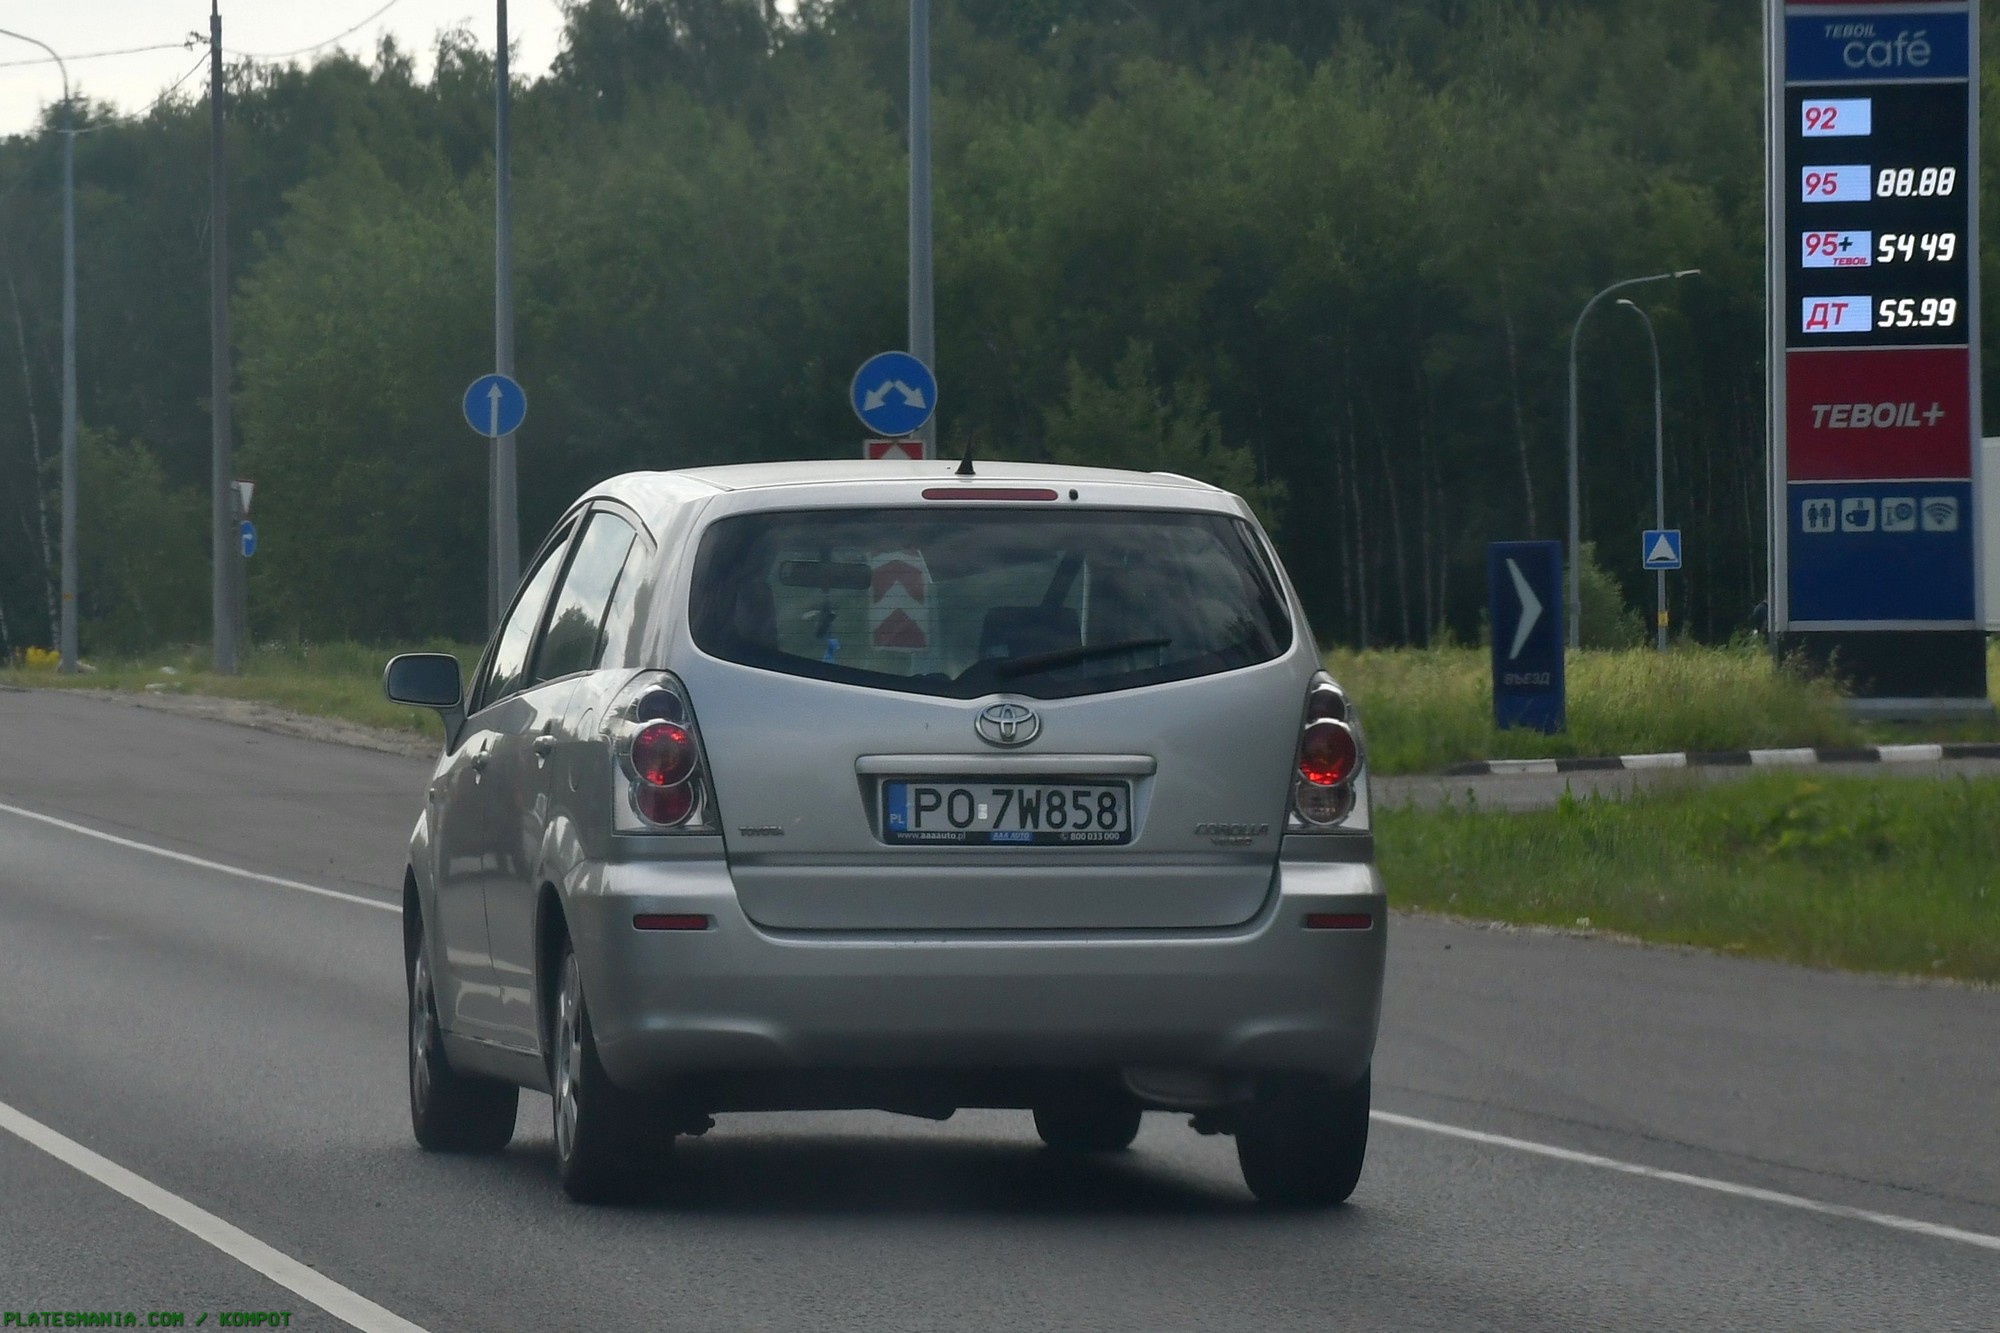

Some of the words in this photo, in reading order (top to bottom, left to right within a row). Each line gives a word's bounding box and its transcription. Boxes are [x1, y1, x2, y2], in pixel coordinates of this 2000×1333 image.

[1824, 24, 1876, 38] TEBOIL
[1843, 30, 1931, 68] café
[1805, 107, 1837, 130] 92
[1805, 172, 1838, 196] 95
[1876, 167, 1956, 197] 88.88
[1805, 233, 1853, 257] 95+
[1833, 257, 1869, 266] TEBOIL
[1806, 303, 1848, 330] ДТ
[1877, 298, 1957, 327] 55.99
[914, 788, 975, 829] PO
[991, 789, 1118, 830] 7W858
[890, 813, 904, 824] PL
[897, 831, 966, 840] www.aaaauto.pl
[993, 831, 1007, 841] AAA
[1012, 831, 1030, 841] AUTO
[1070, 832, 1085, 841] 800
[1104, 832, 1120, 841] 000
